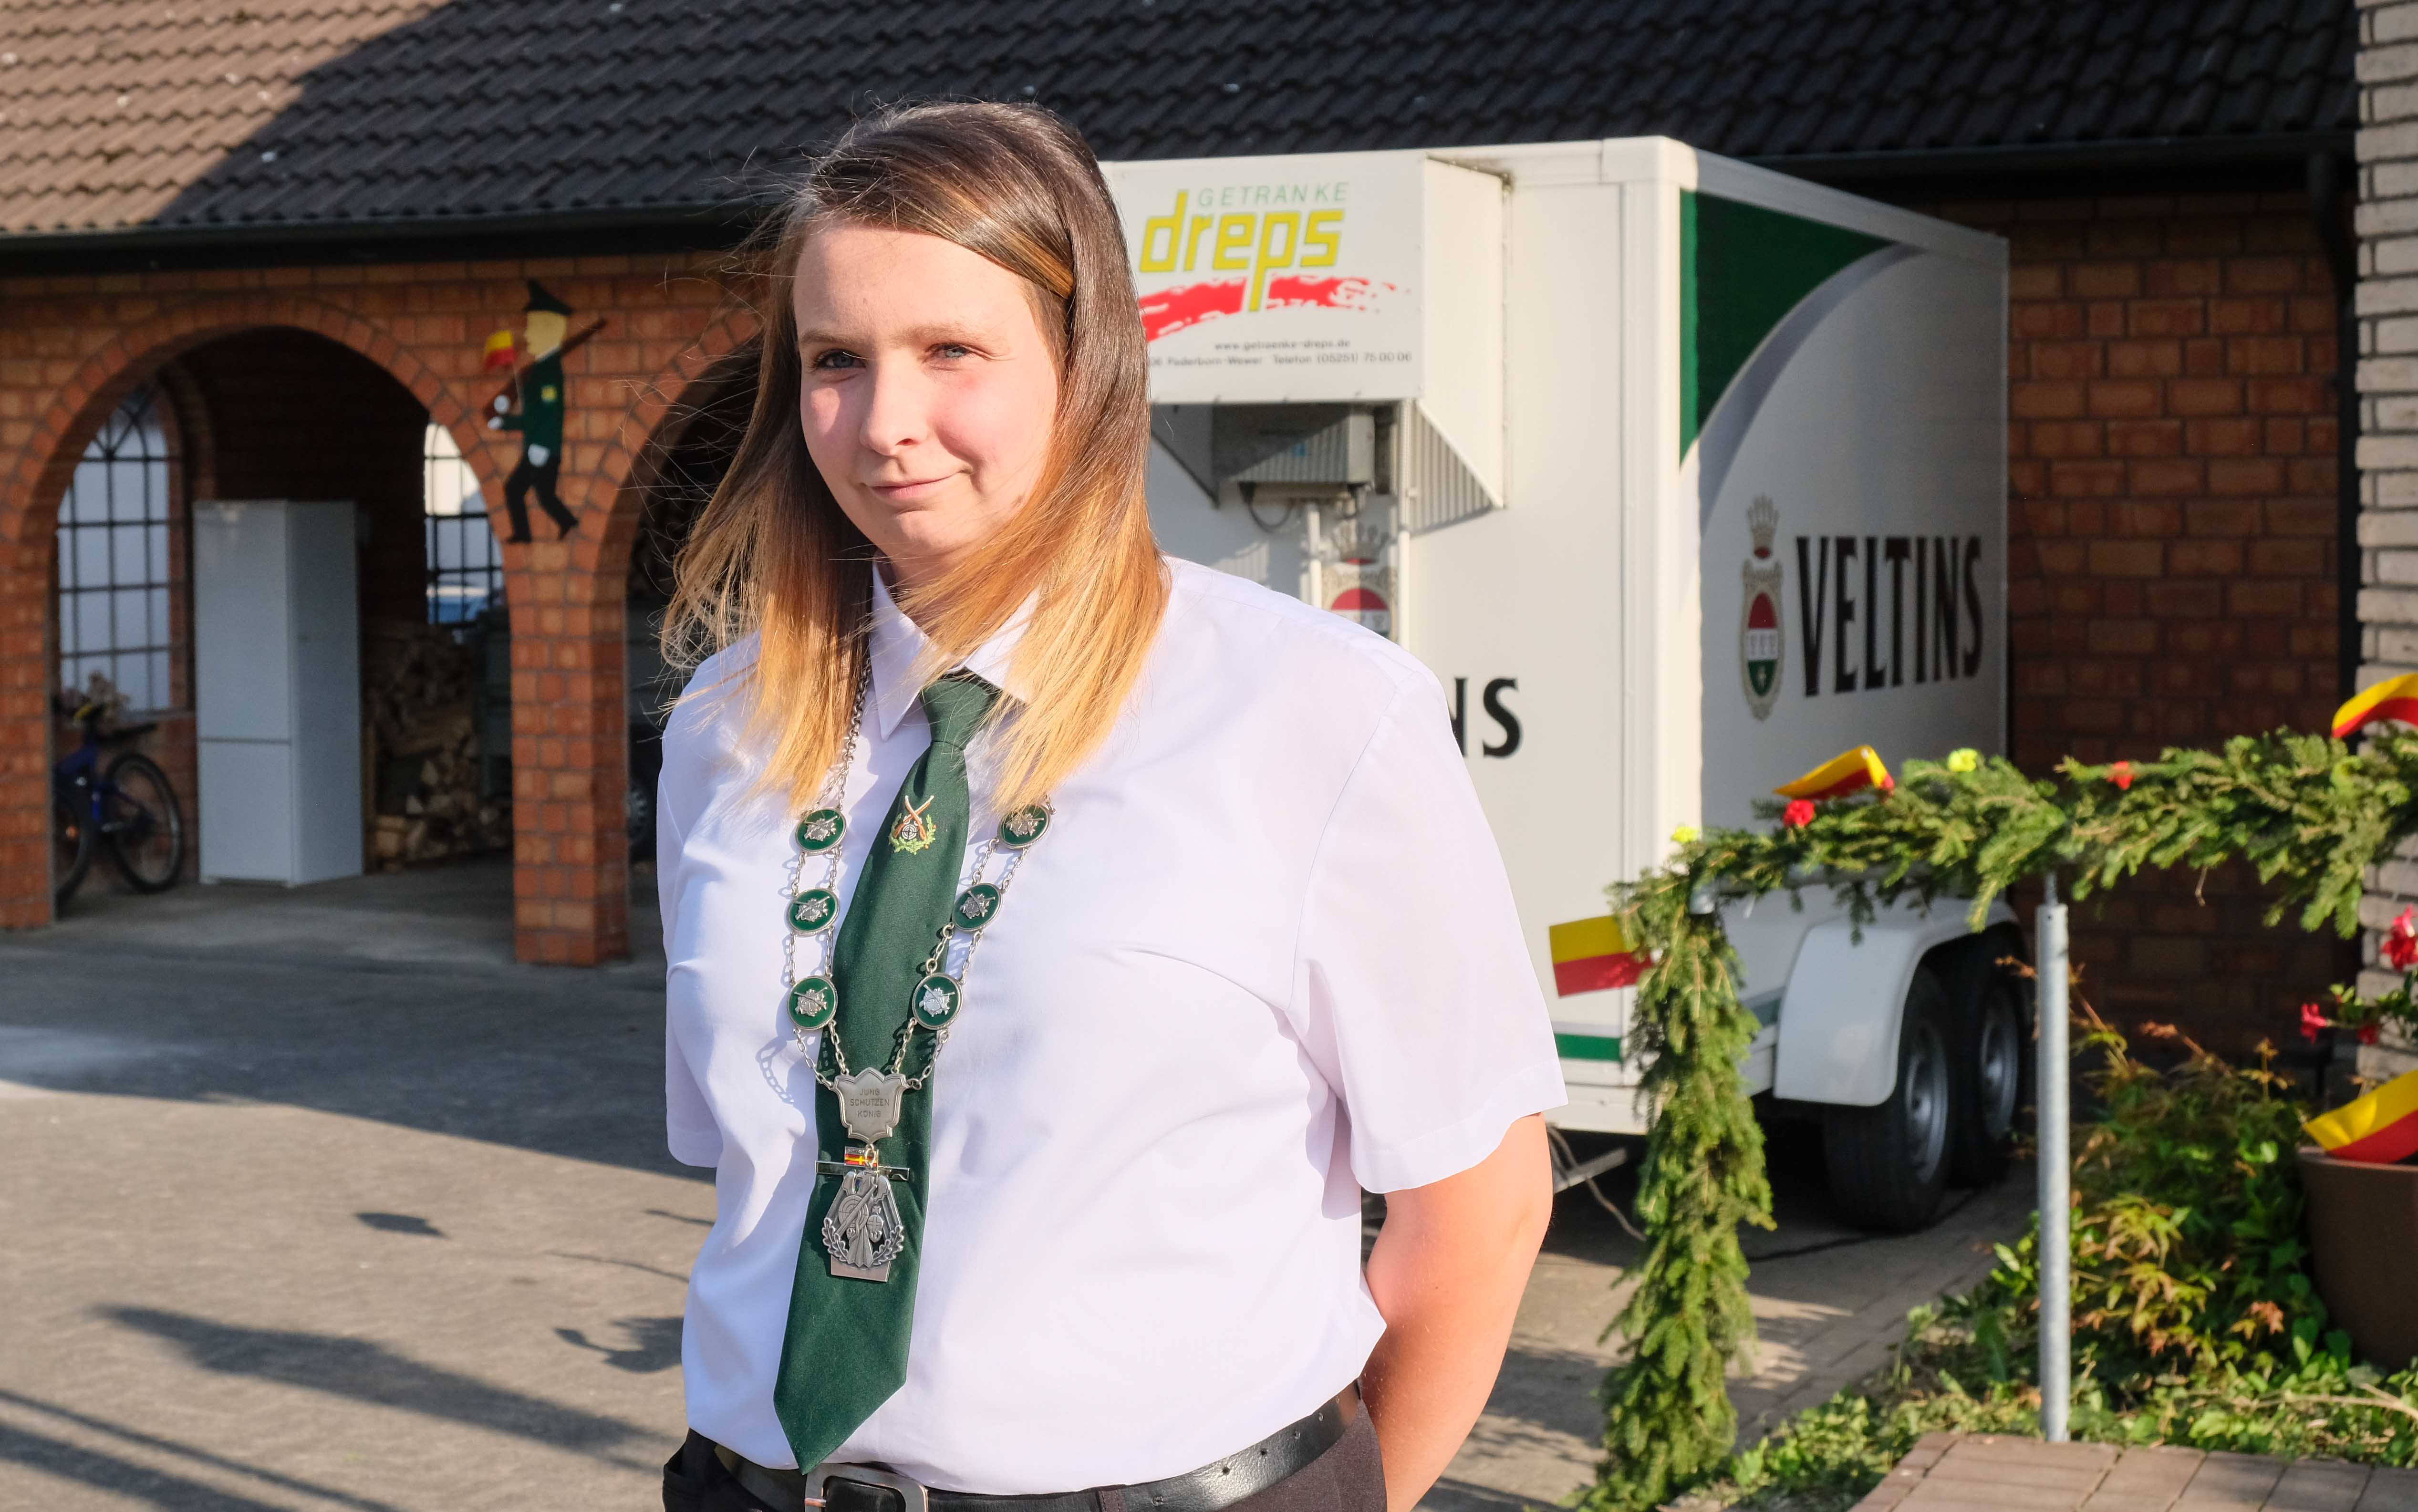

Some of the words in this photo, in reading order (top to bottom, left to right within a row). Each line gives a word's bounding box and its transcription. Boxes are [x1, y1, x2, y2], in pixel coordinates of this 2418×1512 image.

[1139, 190, 1344, 312] dreps
[1273, 353, 1311, 364] Telefon
[1317, 352, 1359, 364] (05251)
[1364, 352, 1378, 364] 75
[1379, 351, 1395, 363] 00
[1796, 536, 1983, 697] VELTINS
